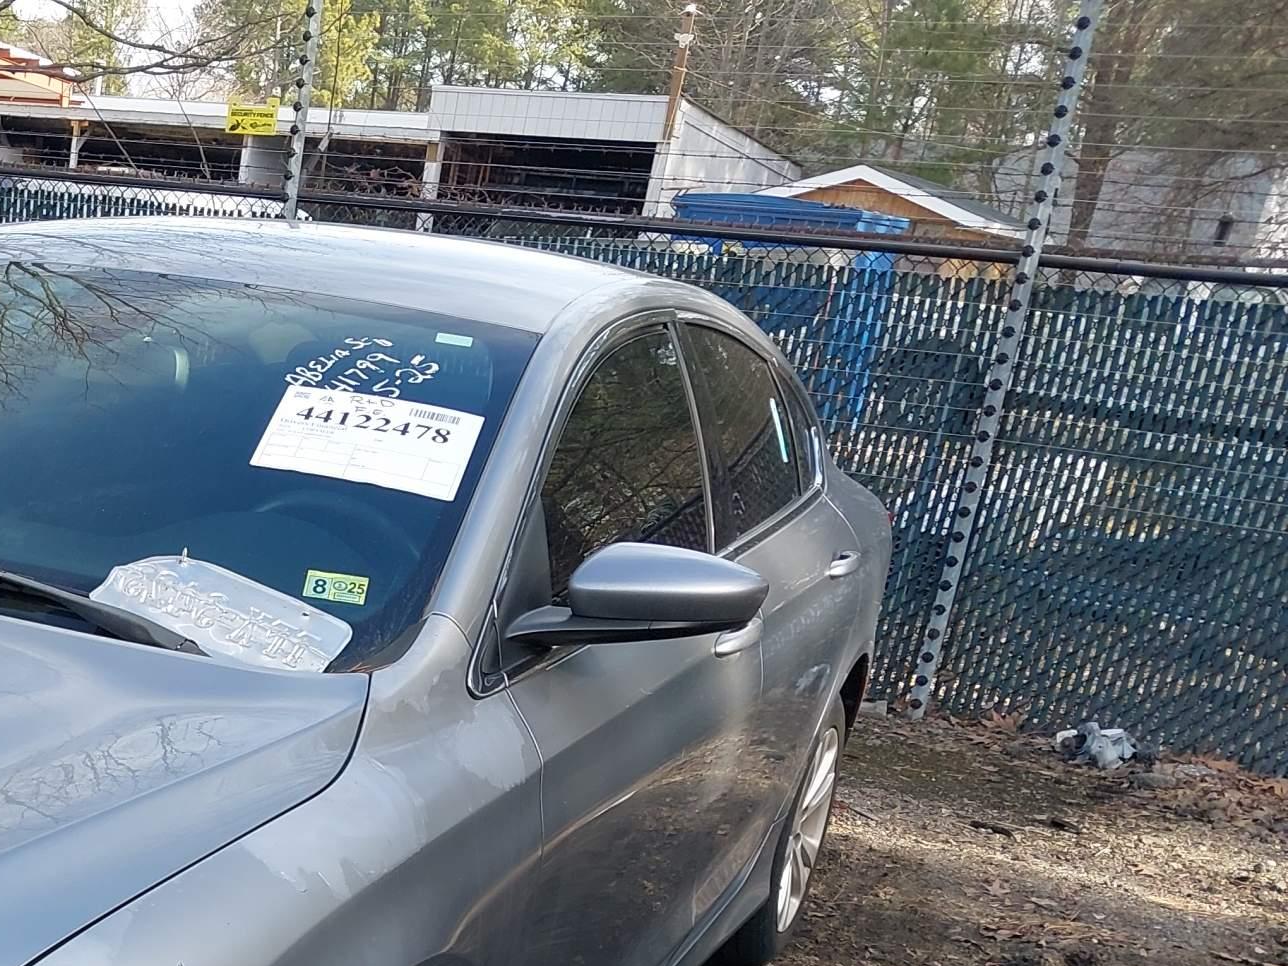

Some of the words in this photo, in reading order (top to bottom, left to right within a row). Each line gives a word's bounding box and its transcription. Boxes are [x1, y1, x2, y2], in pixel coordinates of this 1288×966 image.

[296, 406, 451, 444] 44122478
[312, 578, 327, 594] 8
[347, 582, 366, 595] 25
